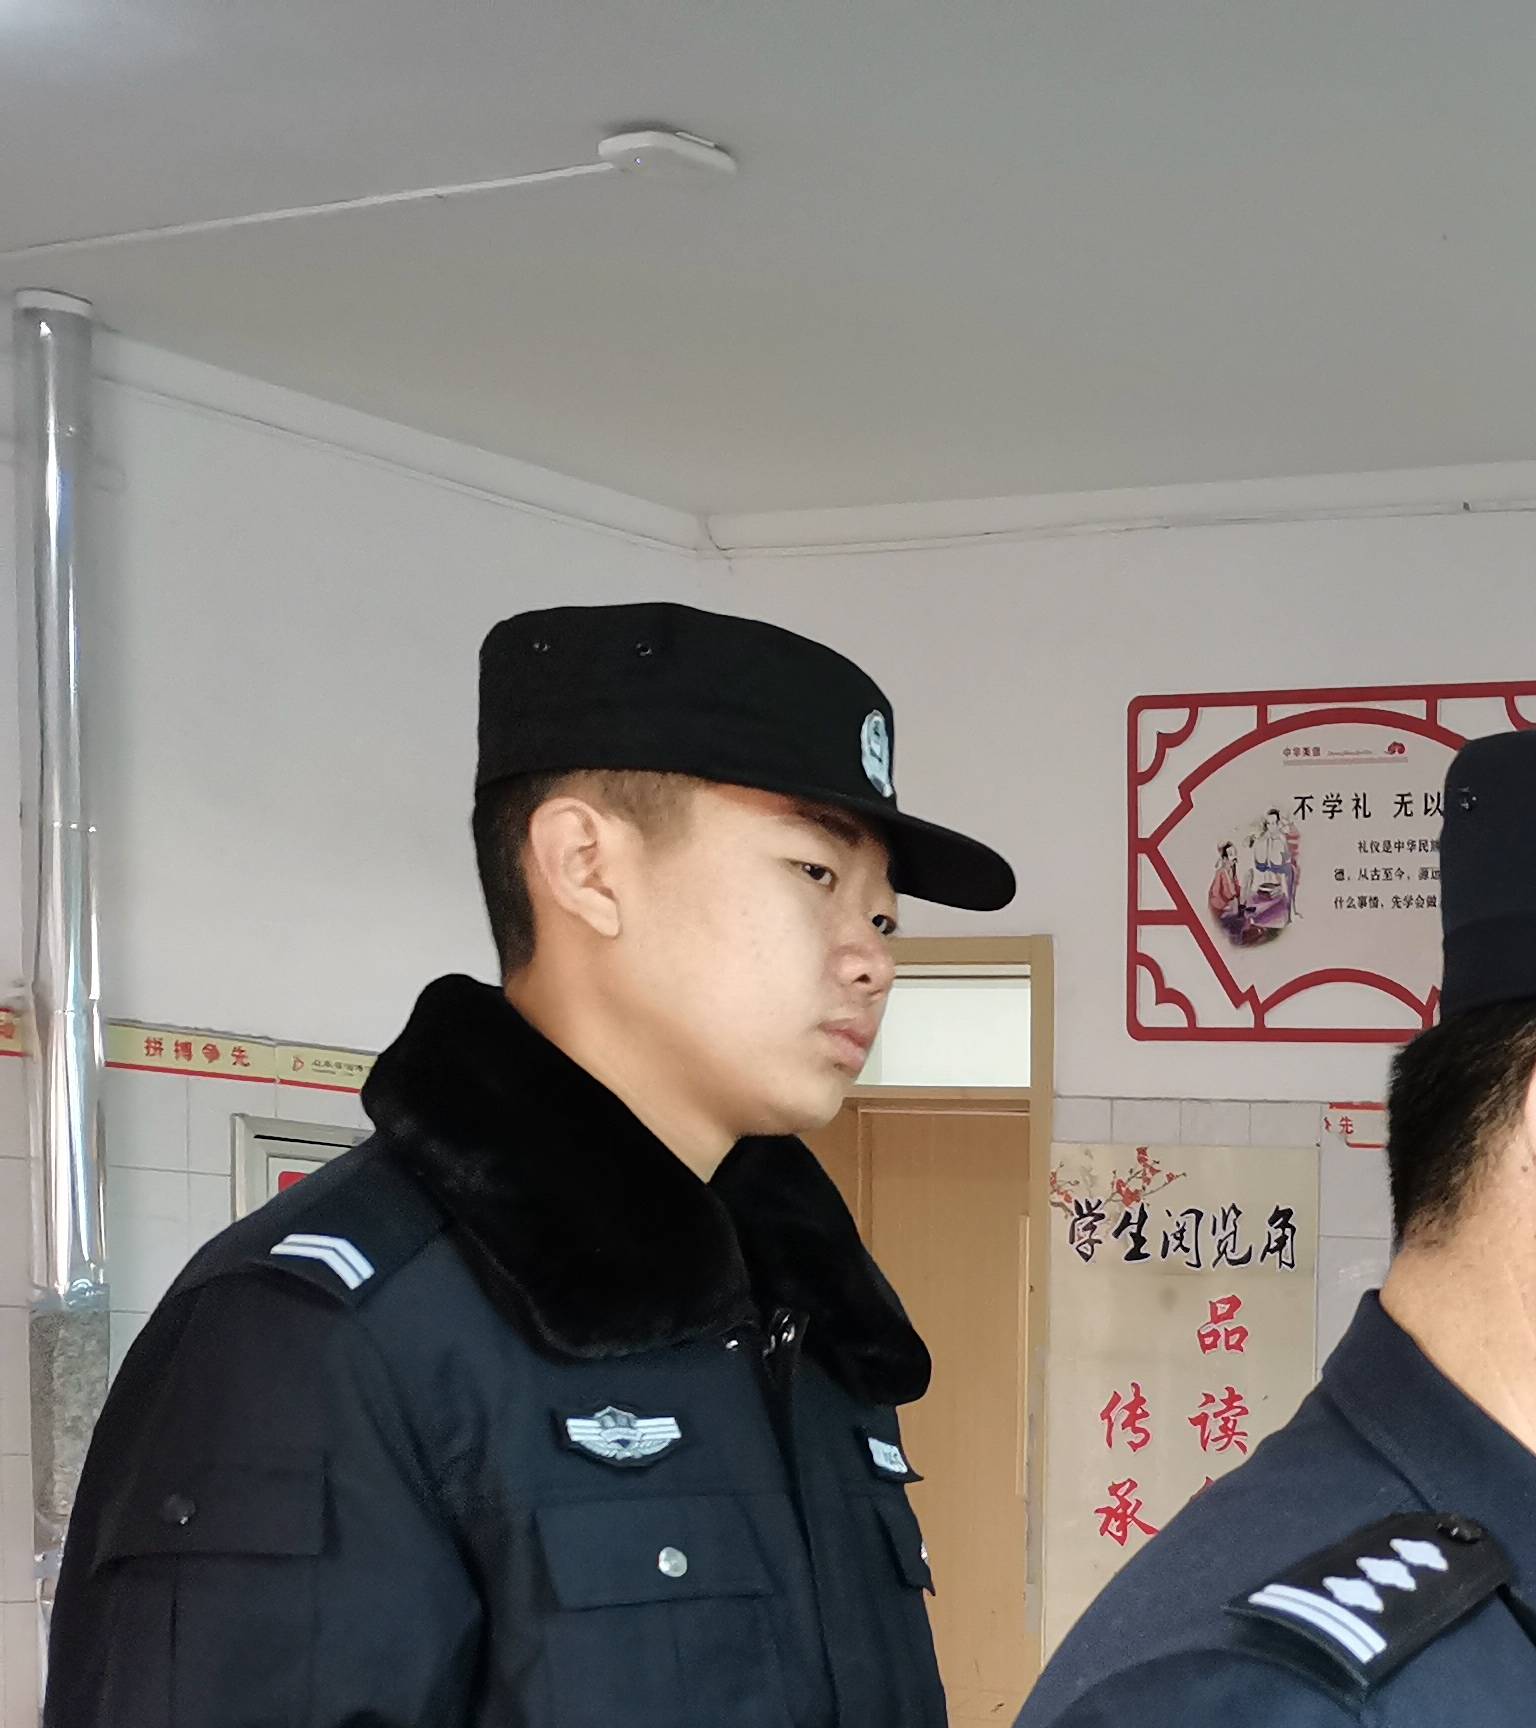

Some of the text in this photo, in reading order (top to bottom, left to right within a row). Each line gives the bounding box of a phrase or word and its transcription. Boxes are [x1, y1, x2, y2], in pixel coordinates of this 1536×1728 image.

[1293, 792, 1444, 820] 不学礼 无以
[1069, 1198, 1300, 1271] 学生阅览角
[1187, 1294, 1250, 1500] 品读
[1094, 1381, 1160, 1546] 传承
